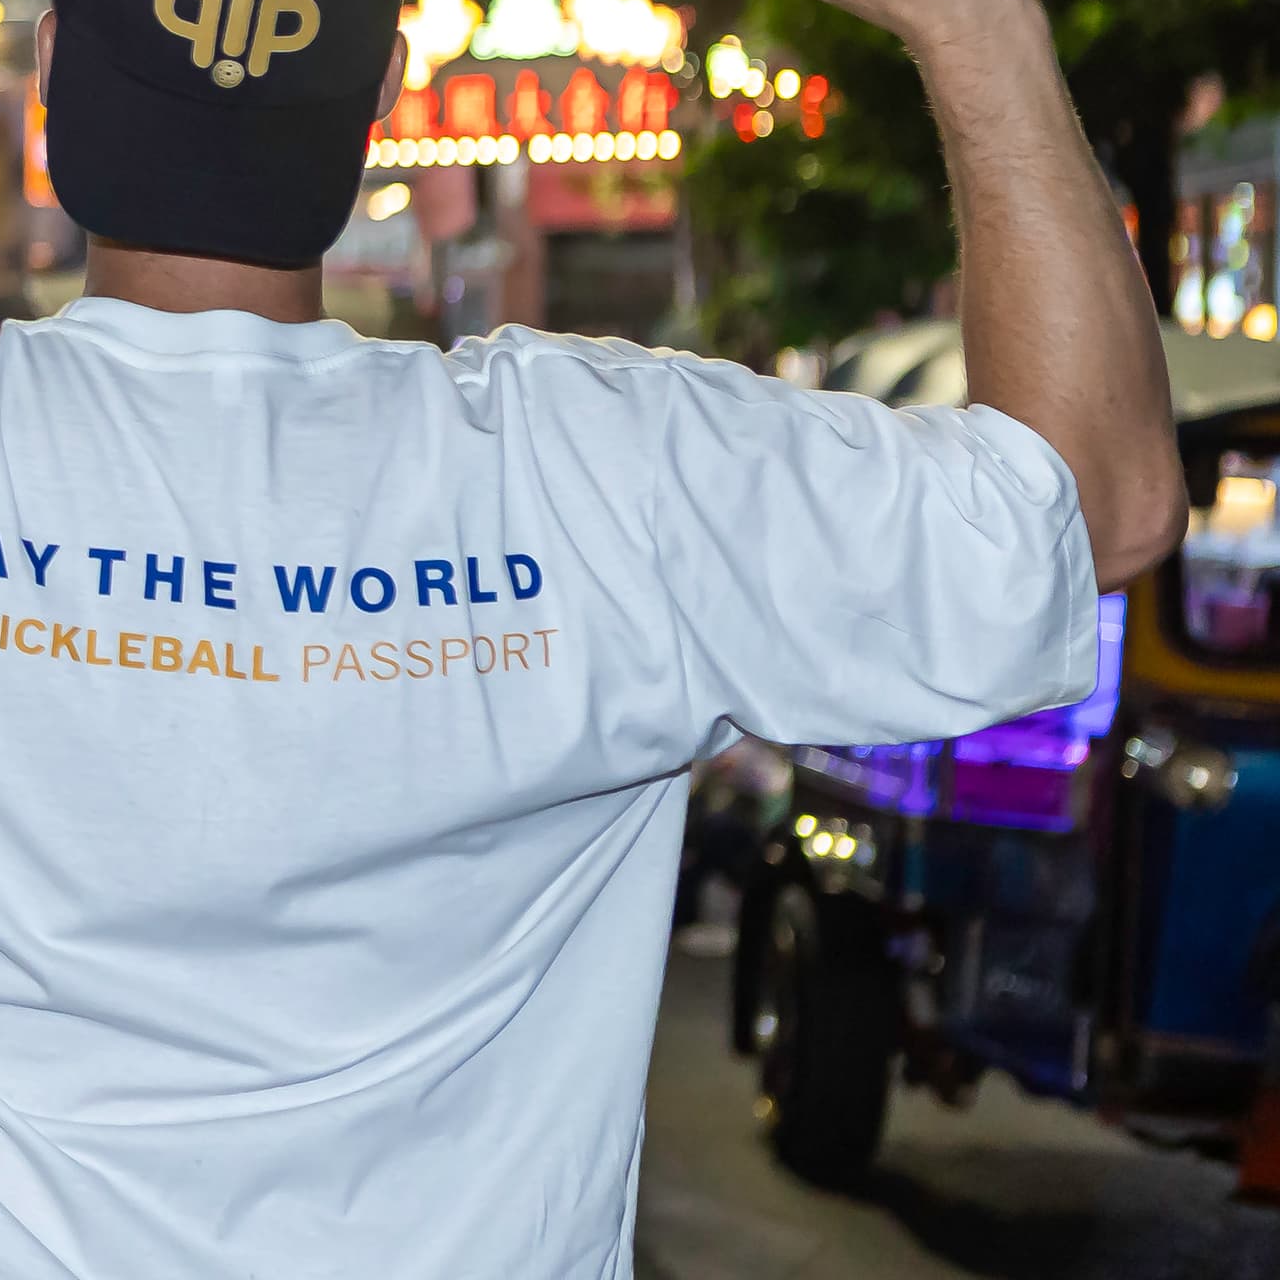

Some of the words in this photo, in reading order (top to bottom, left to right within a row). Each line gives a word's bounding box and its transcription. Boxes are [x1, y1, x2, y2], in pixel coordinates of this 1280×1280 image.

[87, 548, 238, 610] THE
[272, 552, 543, 614] WORLD
[301, 628, 559, 684] PASSPORT
